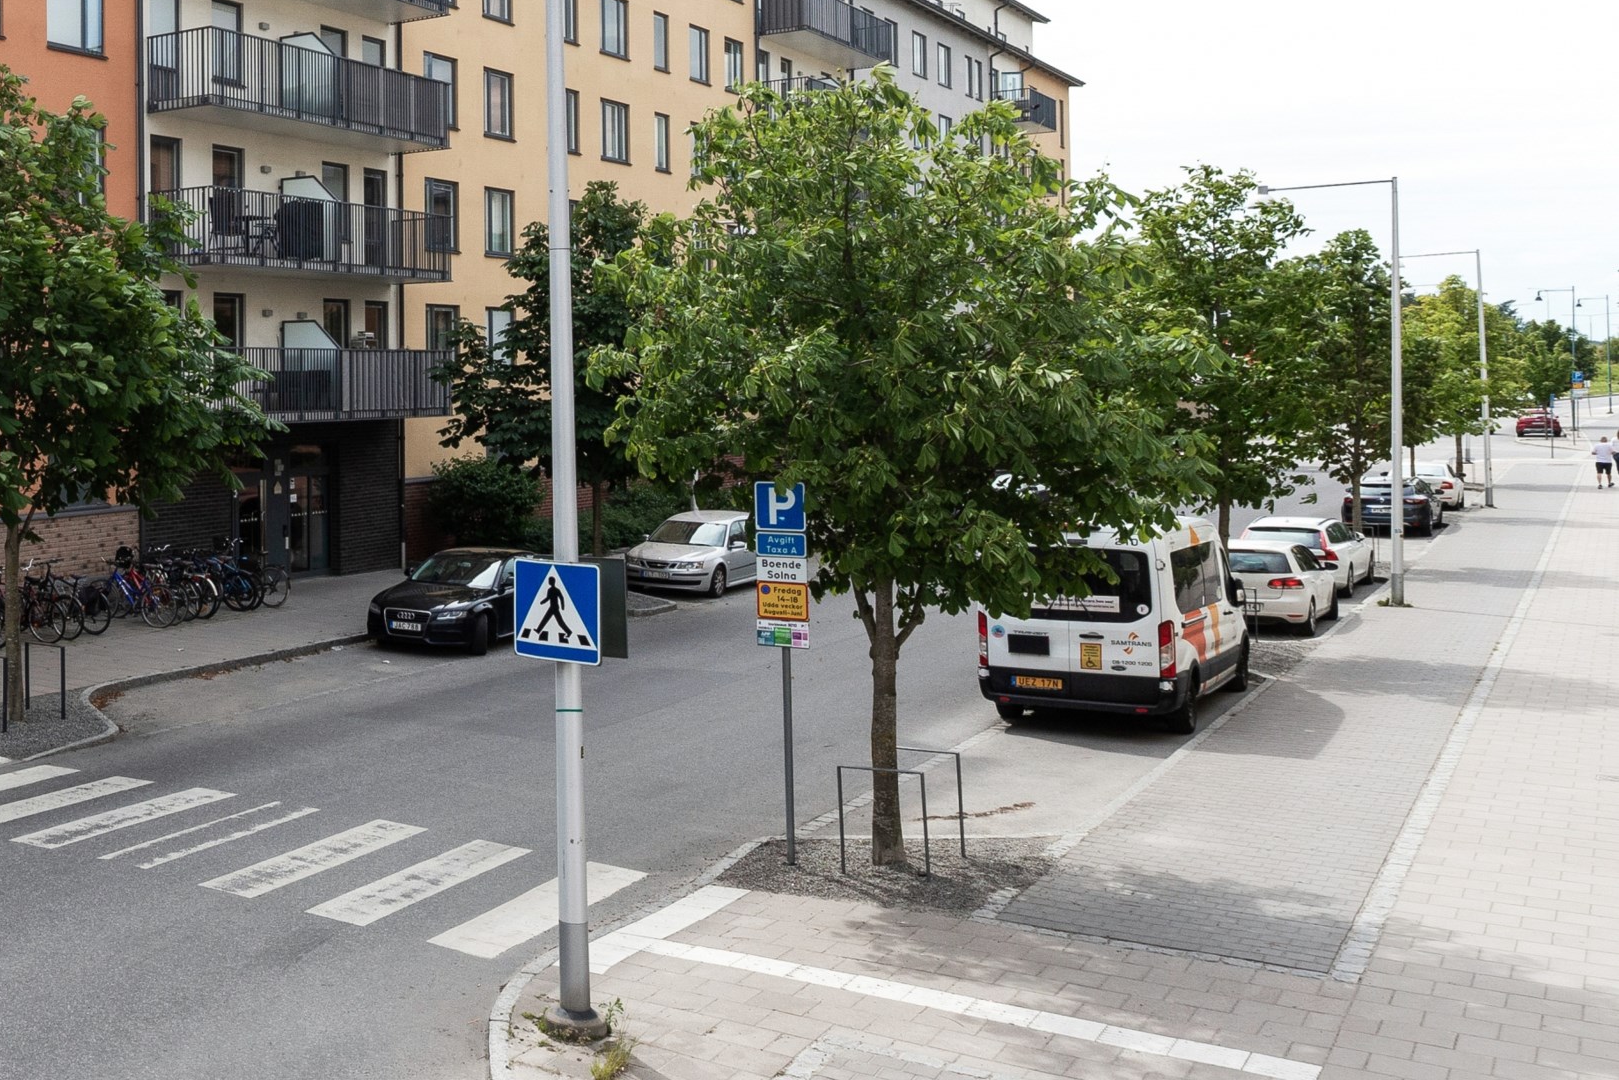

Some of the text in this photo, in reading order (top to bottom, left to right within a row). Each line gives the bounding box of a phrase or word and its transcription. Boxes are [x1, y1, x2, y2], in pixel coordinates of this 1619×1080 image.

[768, 487, 796, 525] P
[767, 535, 795, 545] Avgift
[766, 545, 797, 554] Taxa A
[761, 558, 802, 570] Boende
[767, 570, 797, 580] Solna
[773, 586, 802, 596] Fredag
[1110, 639, 1152, 647] SAMTRANS
[1018, 677, 1059, 687] UEZ 17N
